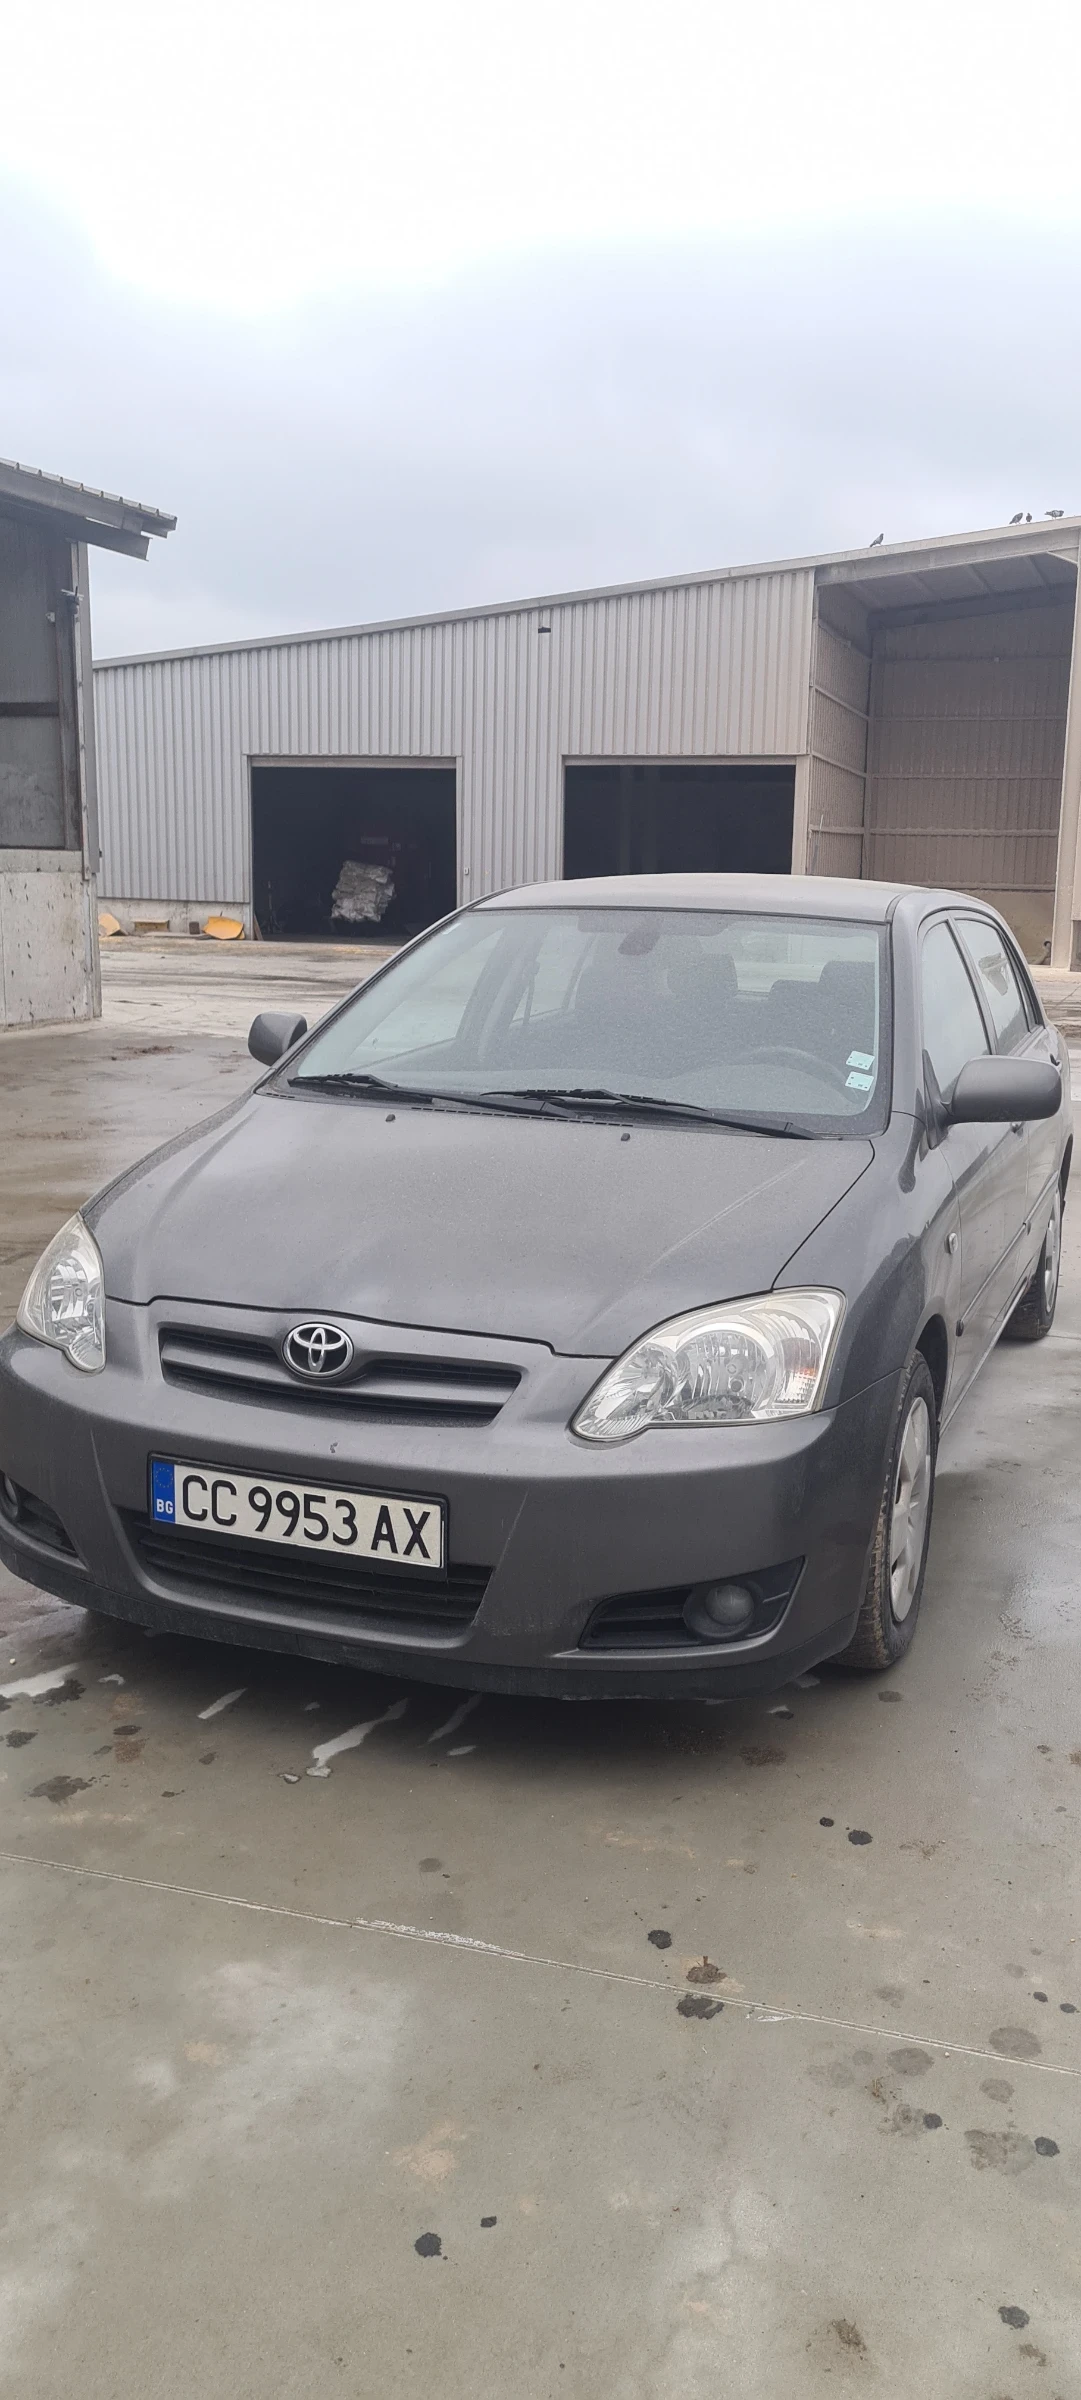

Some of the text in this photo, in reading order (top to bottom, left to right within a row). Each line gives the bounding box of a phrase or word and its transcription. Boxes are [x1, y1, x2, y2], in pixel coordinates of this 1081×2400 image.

[156, 1498, 173, 1514] BG
[182, 1474, 431, 1559] CC 9953 AX
